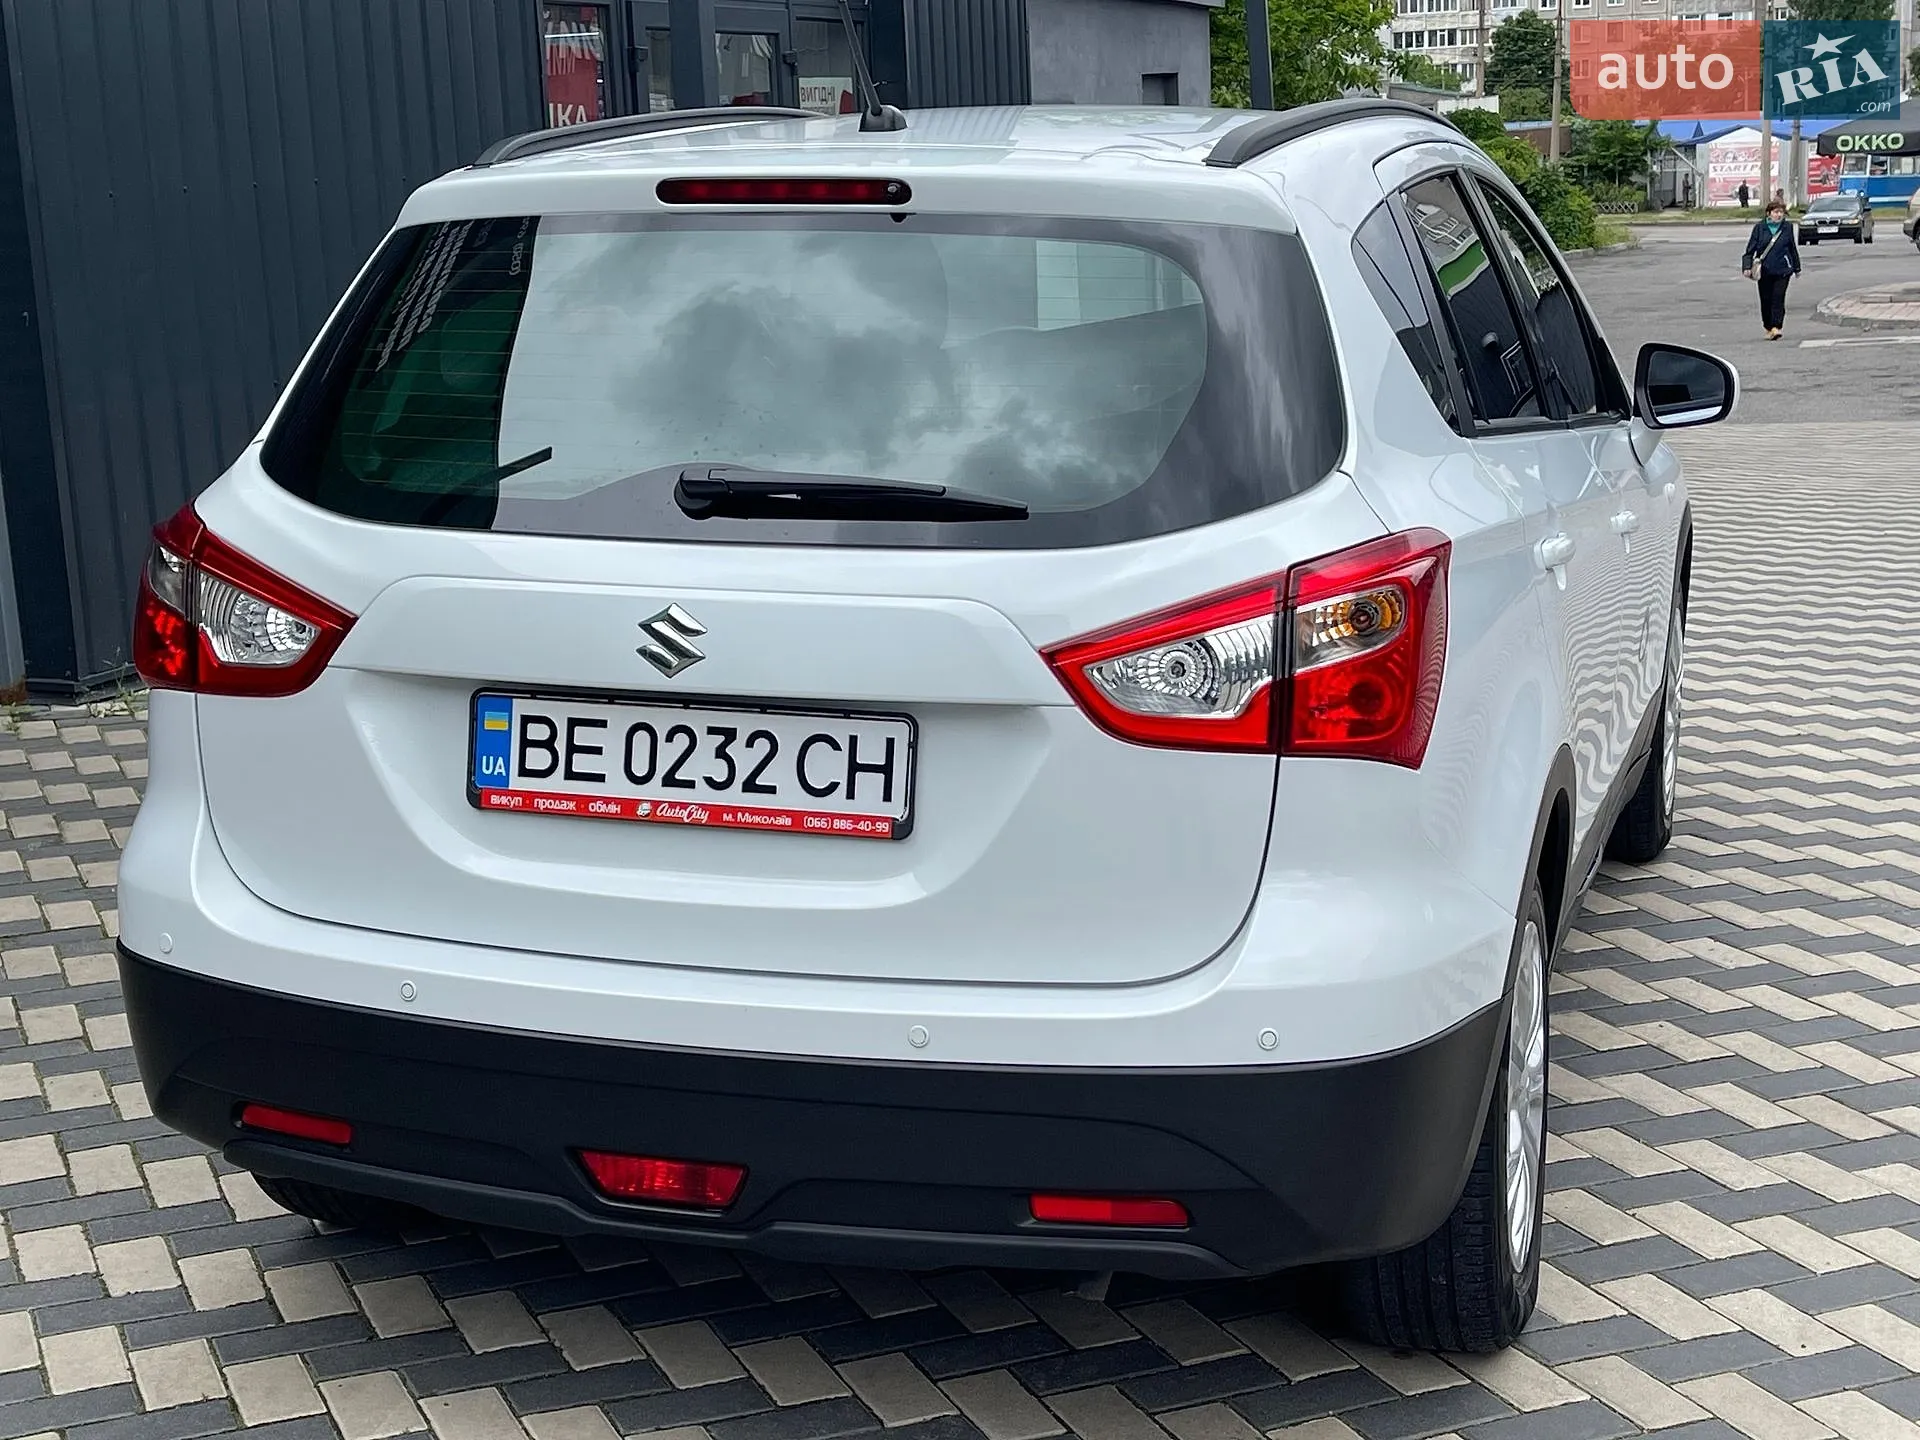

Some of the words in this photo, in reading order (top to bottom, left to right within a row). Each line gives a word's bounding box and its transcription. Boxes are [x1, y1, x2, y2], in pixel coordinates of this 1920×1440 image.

[1836, 133, 1905, 152] OKKO
[482, 755, 507, 777] UA
[517, 714, 609, 783] BE
[623, 721, 779, 796] 0232
[796, 733, 896, 803] CH
[490, 794, 523, 809] викуп
[533, 797, 577, 811] продаж
[588, 800, 621, 814] обмін
[656, 802, 710, 824] AutoCity
[722, 812, 736, 822] м.
[737, 811, 793, 827] Миколаїв
